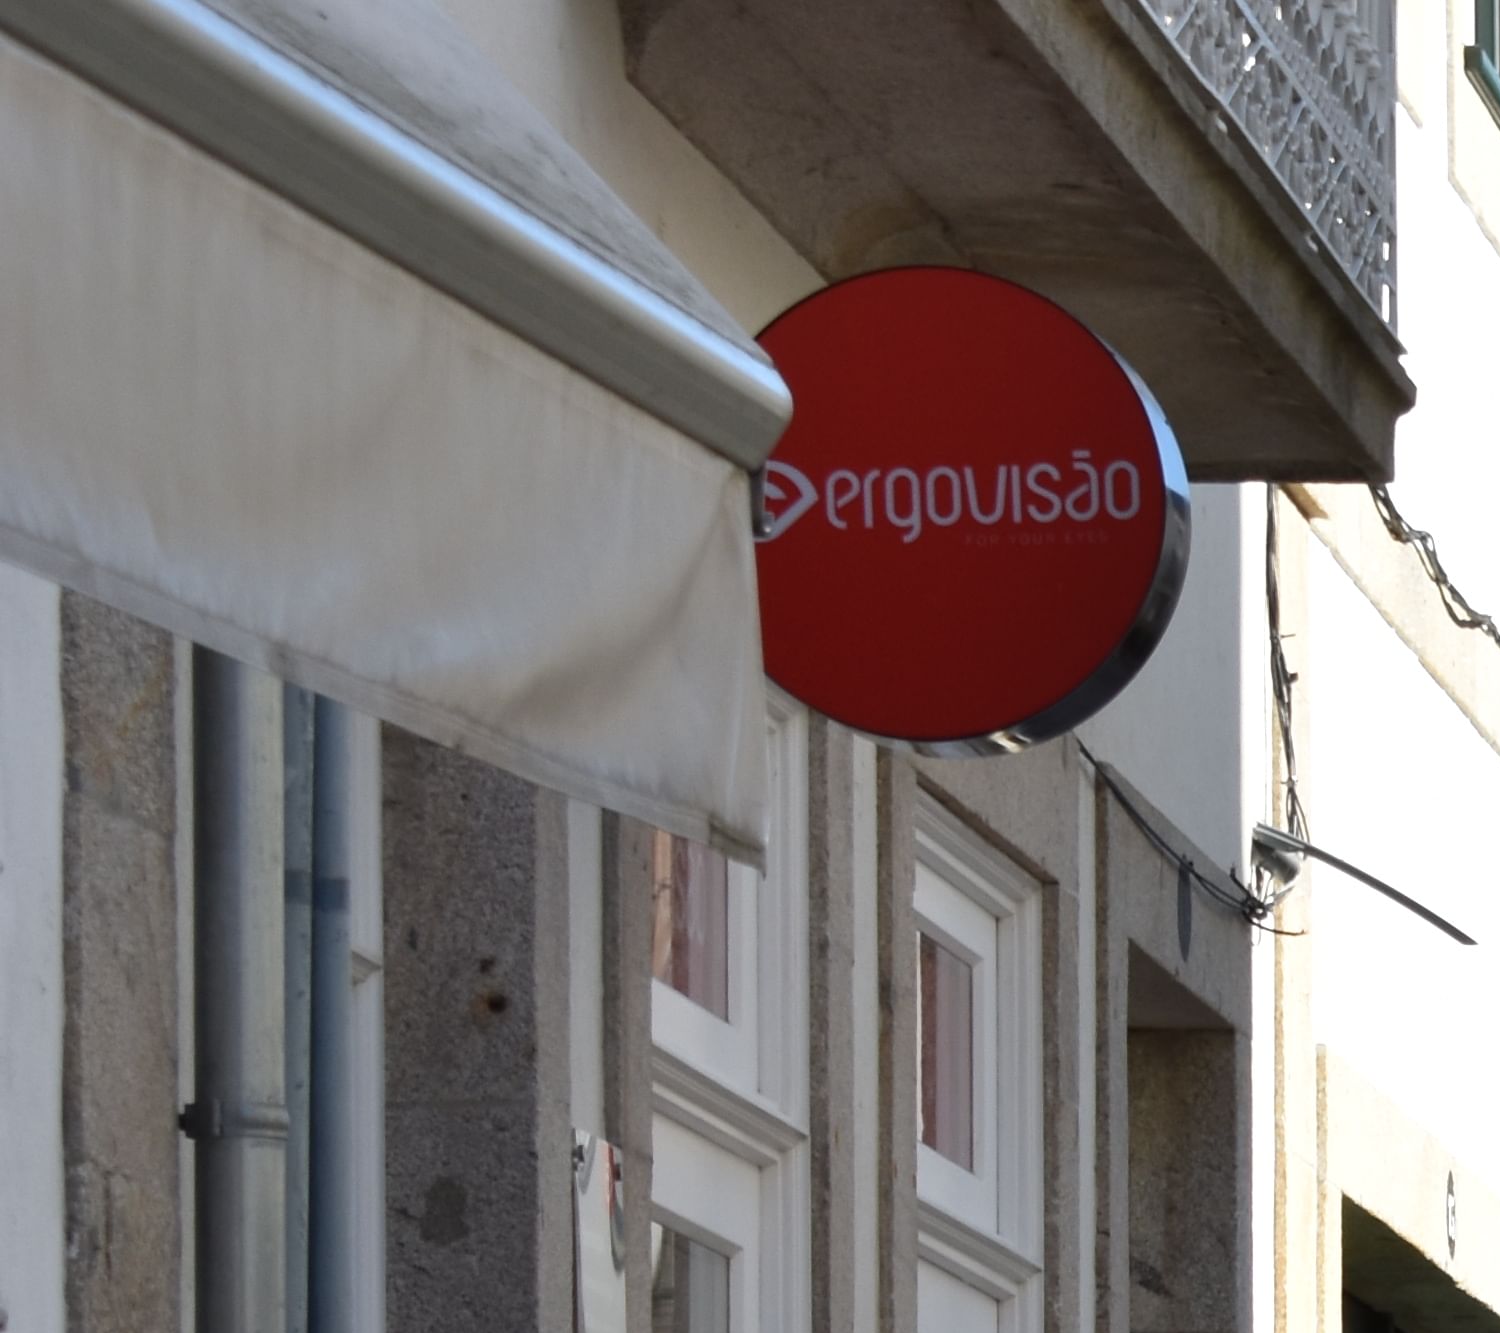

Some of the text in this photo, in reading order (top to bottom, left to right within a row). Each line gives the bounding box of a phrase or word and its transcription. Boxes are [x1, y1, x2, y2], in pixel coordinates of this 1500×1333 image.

[825, 449, 1141, 543] ergovisão
[965, 529, 1110, 547] FOR YOUR EYES
